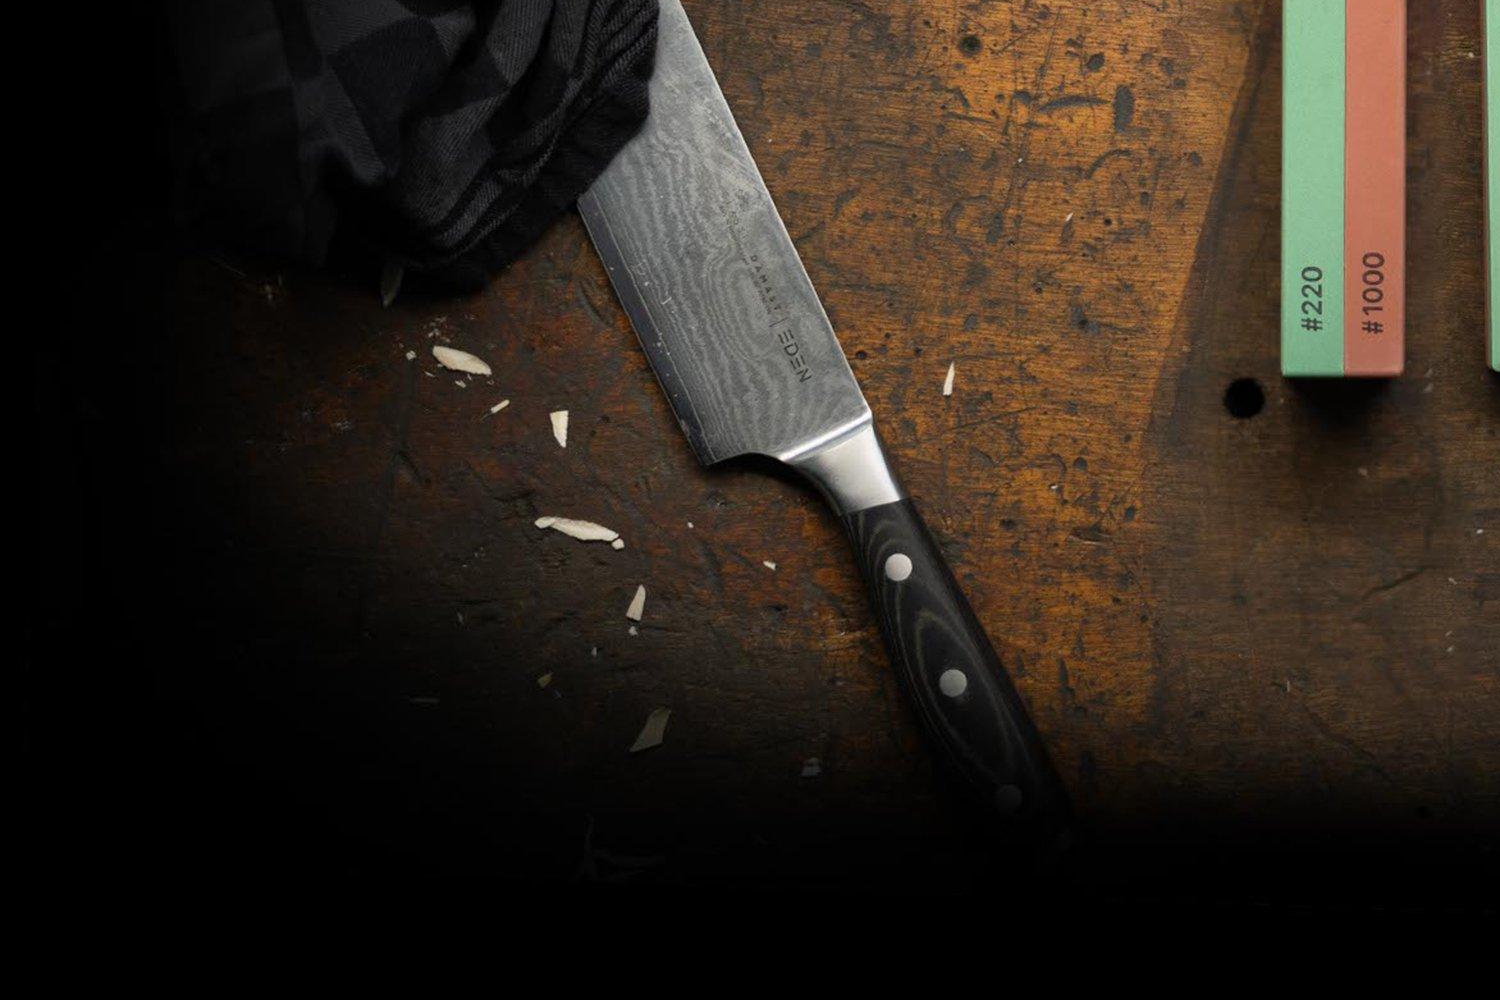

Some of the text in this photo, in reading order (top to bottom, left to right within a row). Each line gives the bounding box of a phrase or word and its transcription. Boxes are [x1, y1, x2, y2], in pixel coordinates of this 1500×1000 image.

[1300, 265, 1324, 332] #220
[1361, 251, 1386, 335] #1000
[777, 328, 812, 384] EDEN
